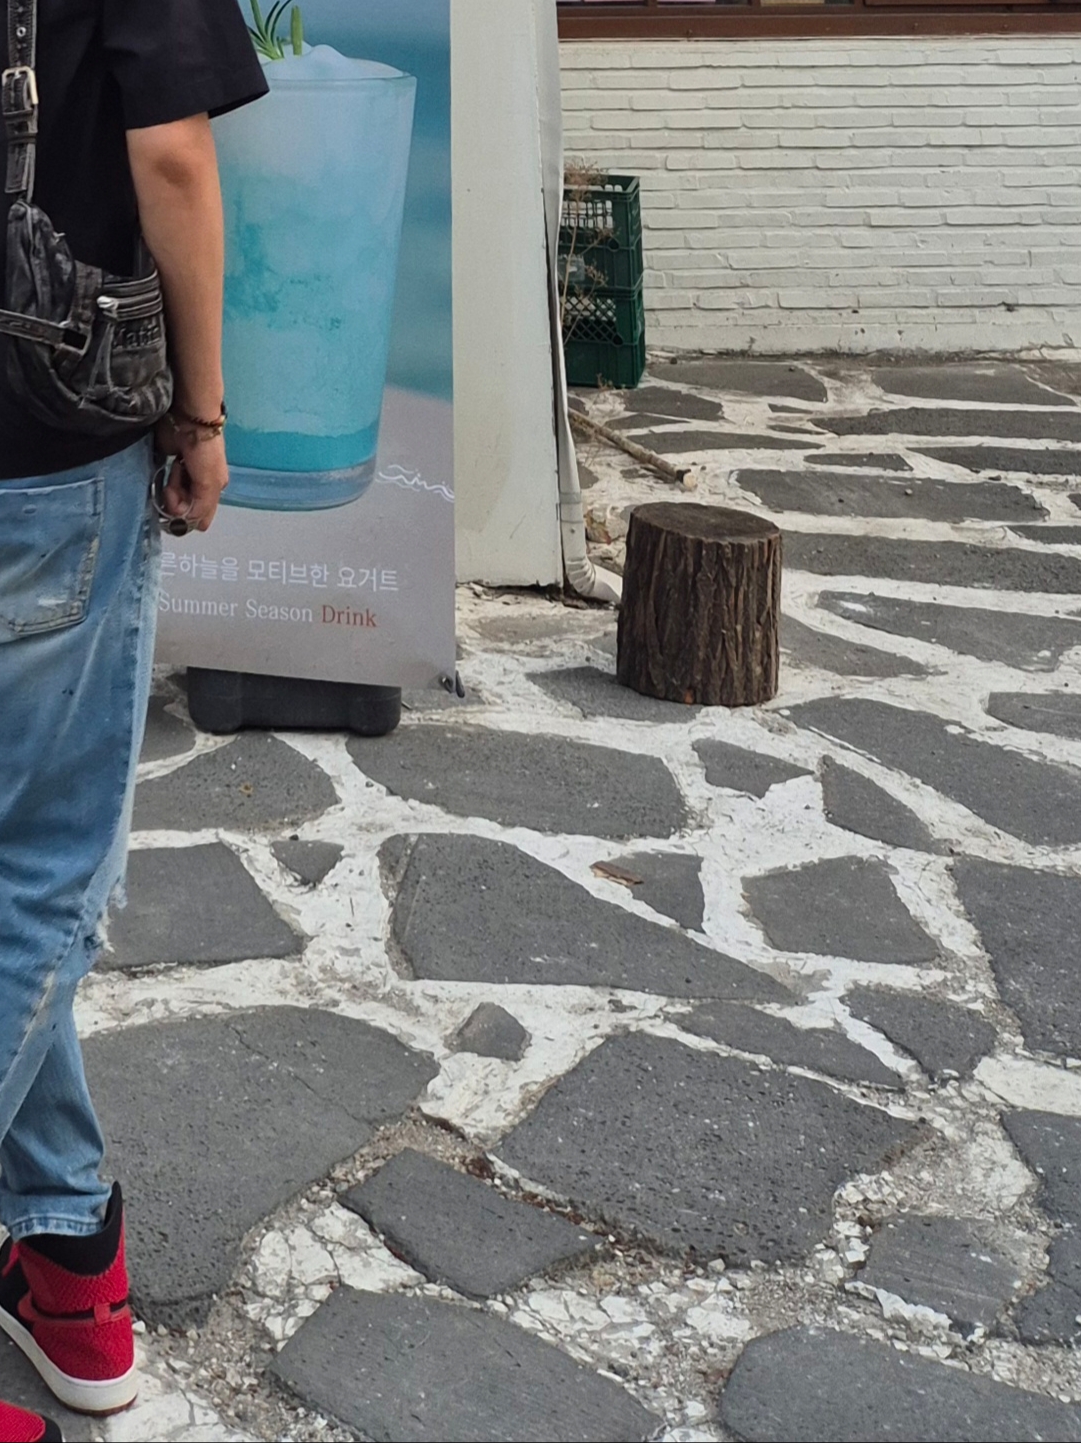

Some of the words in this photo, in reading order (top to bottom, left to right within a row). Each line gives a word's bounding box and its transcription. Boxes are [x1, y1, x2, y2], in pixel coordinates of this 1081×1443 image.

[161, 551, 239, 581] 른하늘을
[246, 559, 329, 588] 모티브한
[337, 566, 399, 592] 요거트
[157, 589, 238, 617] Summer
[245, 598, 313, 623] Season
[322, 604, 378, 628] Drink
